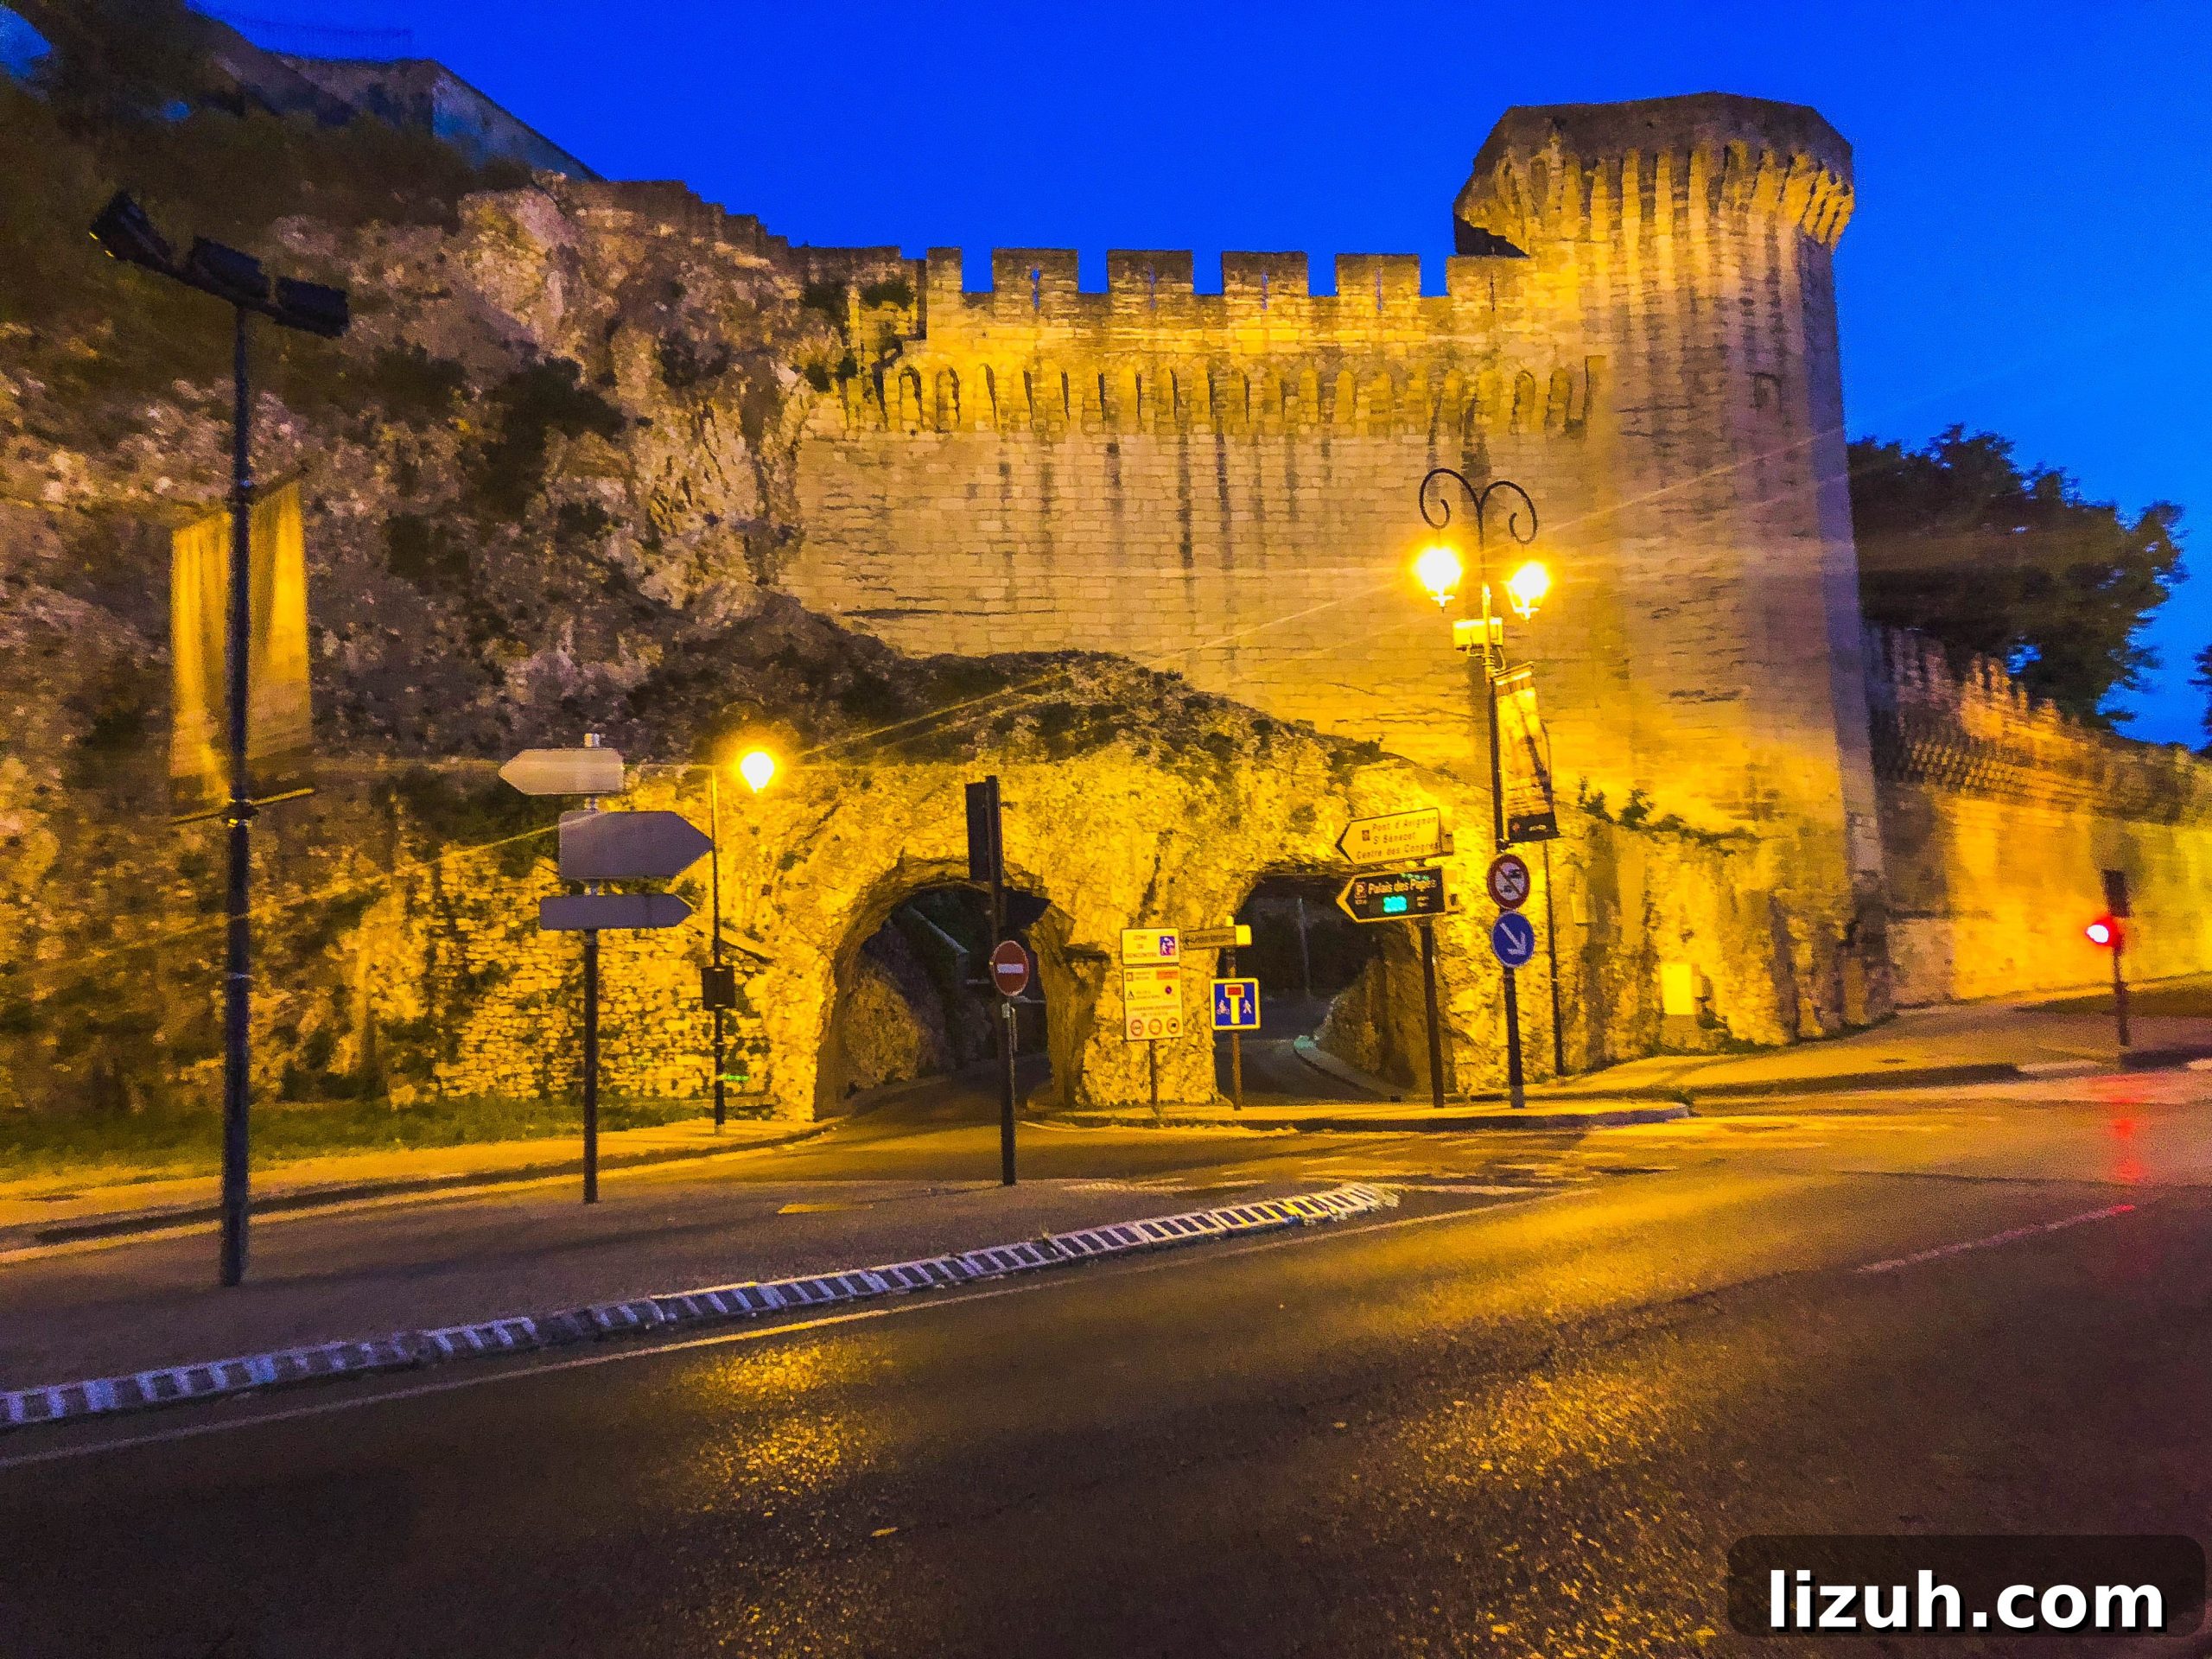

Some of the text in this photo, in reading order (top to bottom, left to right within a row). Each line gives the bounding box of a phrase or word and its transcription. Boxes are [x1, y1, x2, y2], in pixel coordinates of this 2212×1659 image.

[1372, 823, 1391, 831] Pont
[1356, 849, 1382, 860] Centre
[1386, 847, 1402, 856] des
[1368, 881, 1393, 894] Palais
[1393, 879, 1410, 893] des
